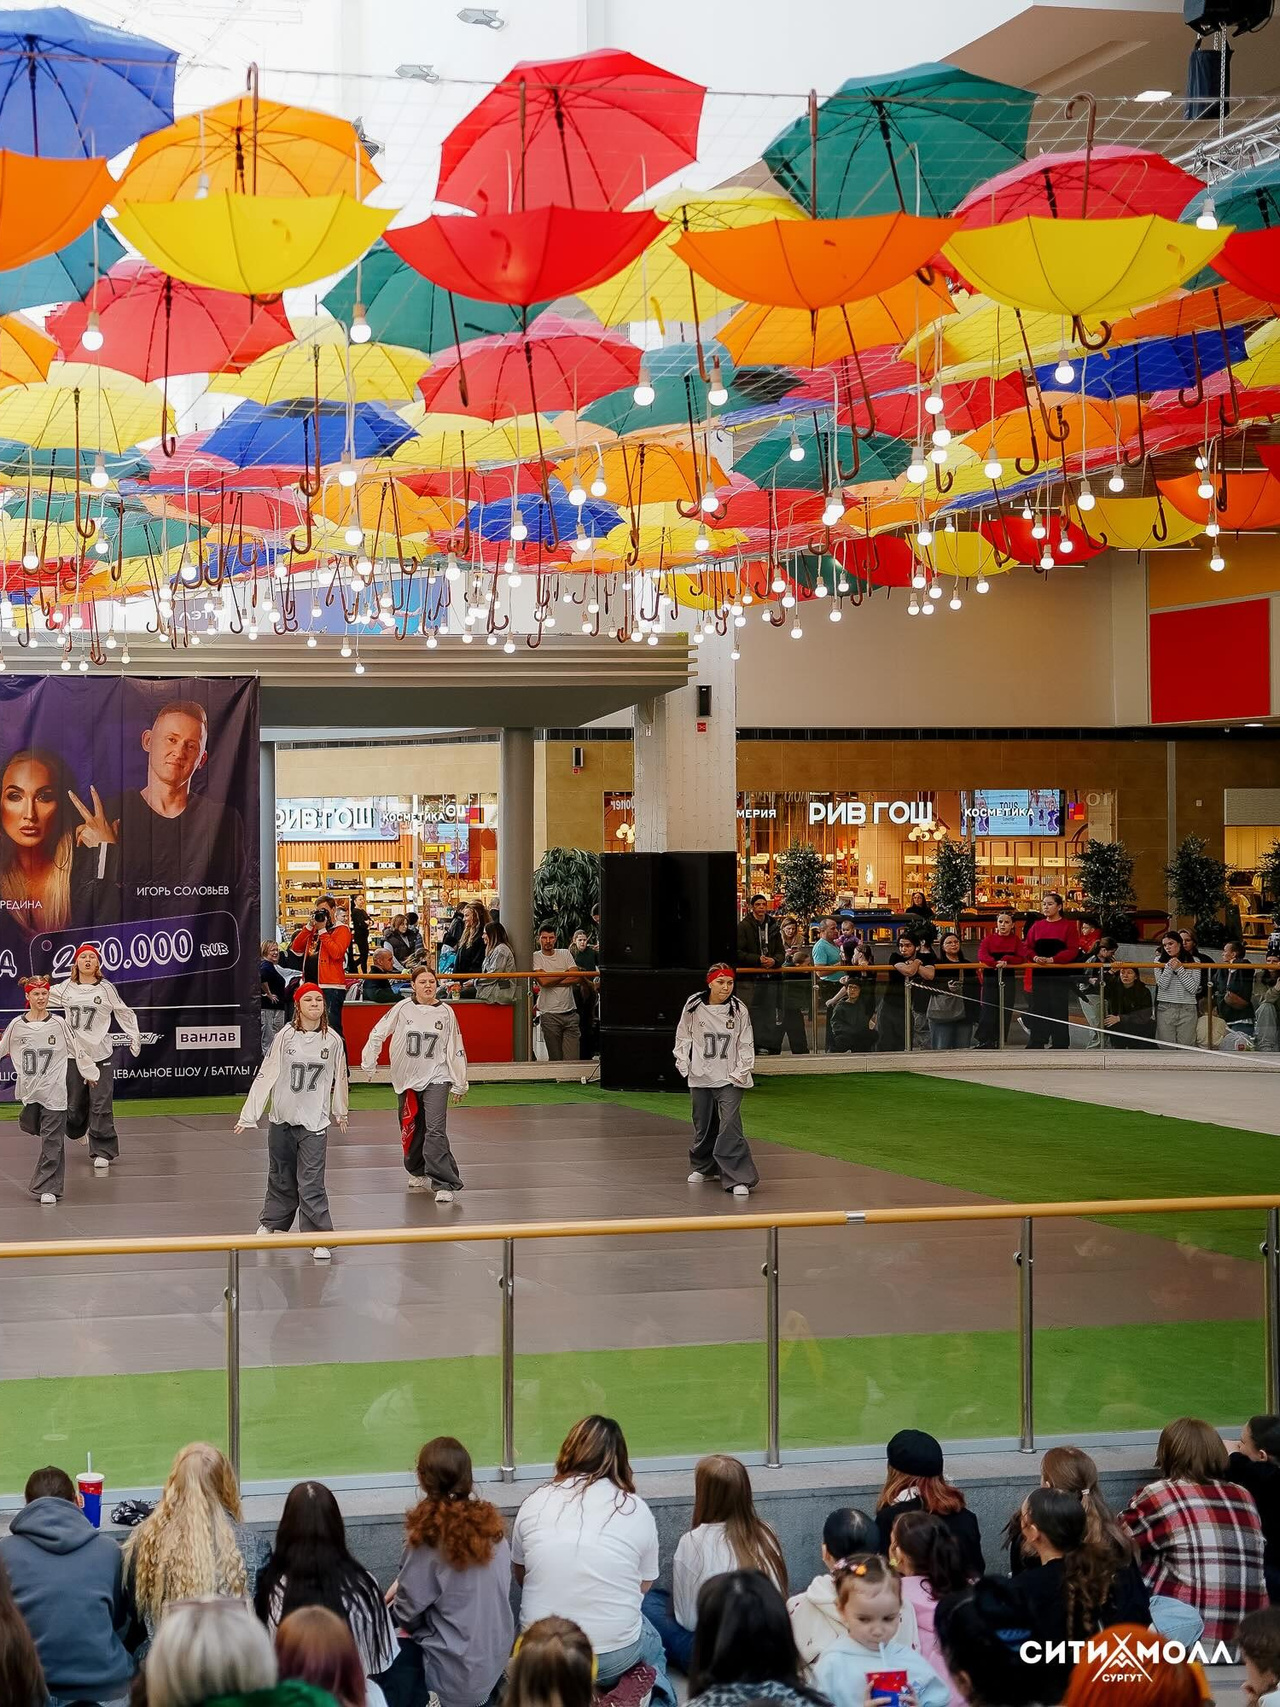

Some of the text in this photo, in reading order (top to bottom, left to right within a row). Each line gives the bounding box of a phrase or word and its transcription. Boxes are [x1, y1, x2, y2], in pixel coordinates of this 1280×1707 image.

[322, 806, 374, 830] ГОШ
[381, 812, 446, 823] КОСМЕТИКА
[808, 801, 933, 826] РИВ ГОШ
[964, 808, 1035, 817] КОСМЕТИКА
[136, 885, 230, 896] ИГОРЬ СОЛОВЬЕВ
[0, 899, 43, 910] РЕДИНА
[200, 942, 229, 957] RUB
[180, 1031, 236, 1044] ванлав
[406, 1031, 440, 1060] 07
[703, 1032, 732, 1060] 07
[22, 1049, 54, 1075] 07
[175, 1066, 202, 1077] ШОУ
[211, 1065, 251, 1076] БАТТЛЫ
[290, 1062, 326, 1094] 07
